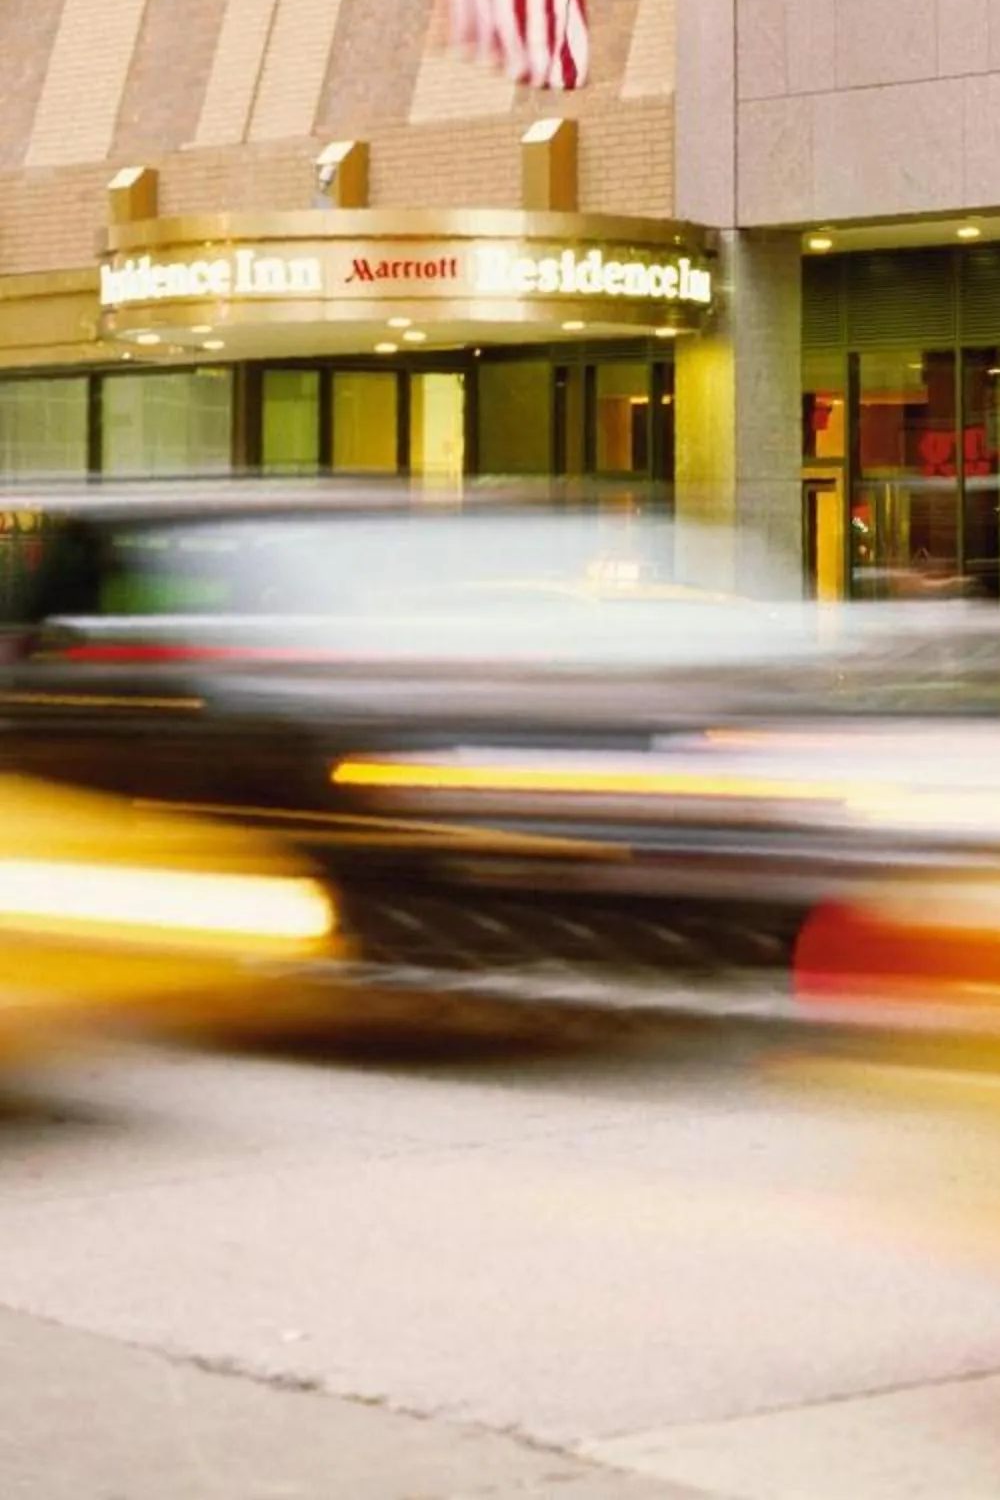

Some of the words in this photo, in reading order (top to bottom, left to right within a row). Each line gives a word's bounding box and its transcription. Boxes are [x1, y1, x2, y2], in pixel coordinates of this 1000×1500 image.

[100, 255, 230, 305] idence
[234, 249, 321, 291] Inn
[344, 258, 457, 283] Marriott
[476, 247, 677, 298] Residence
